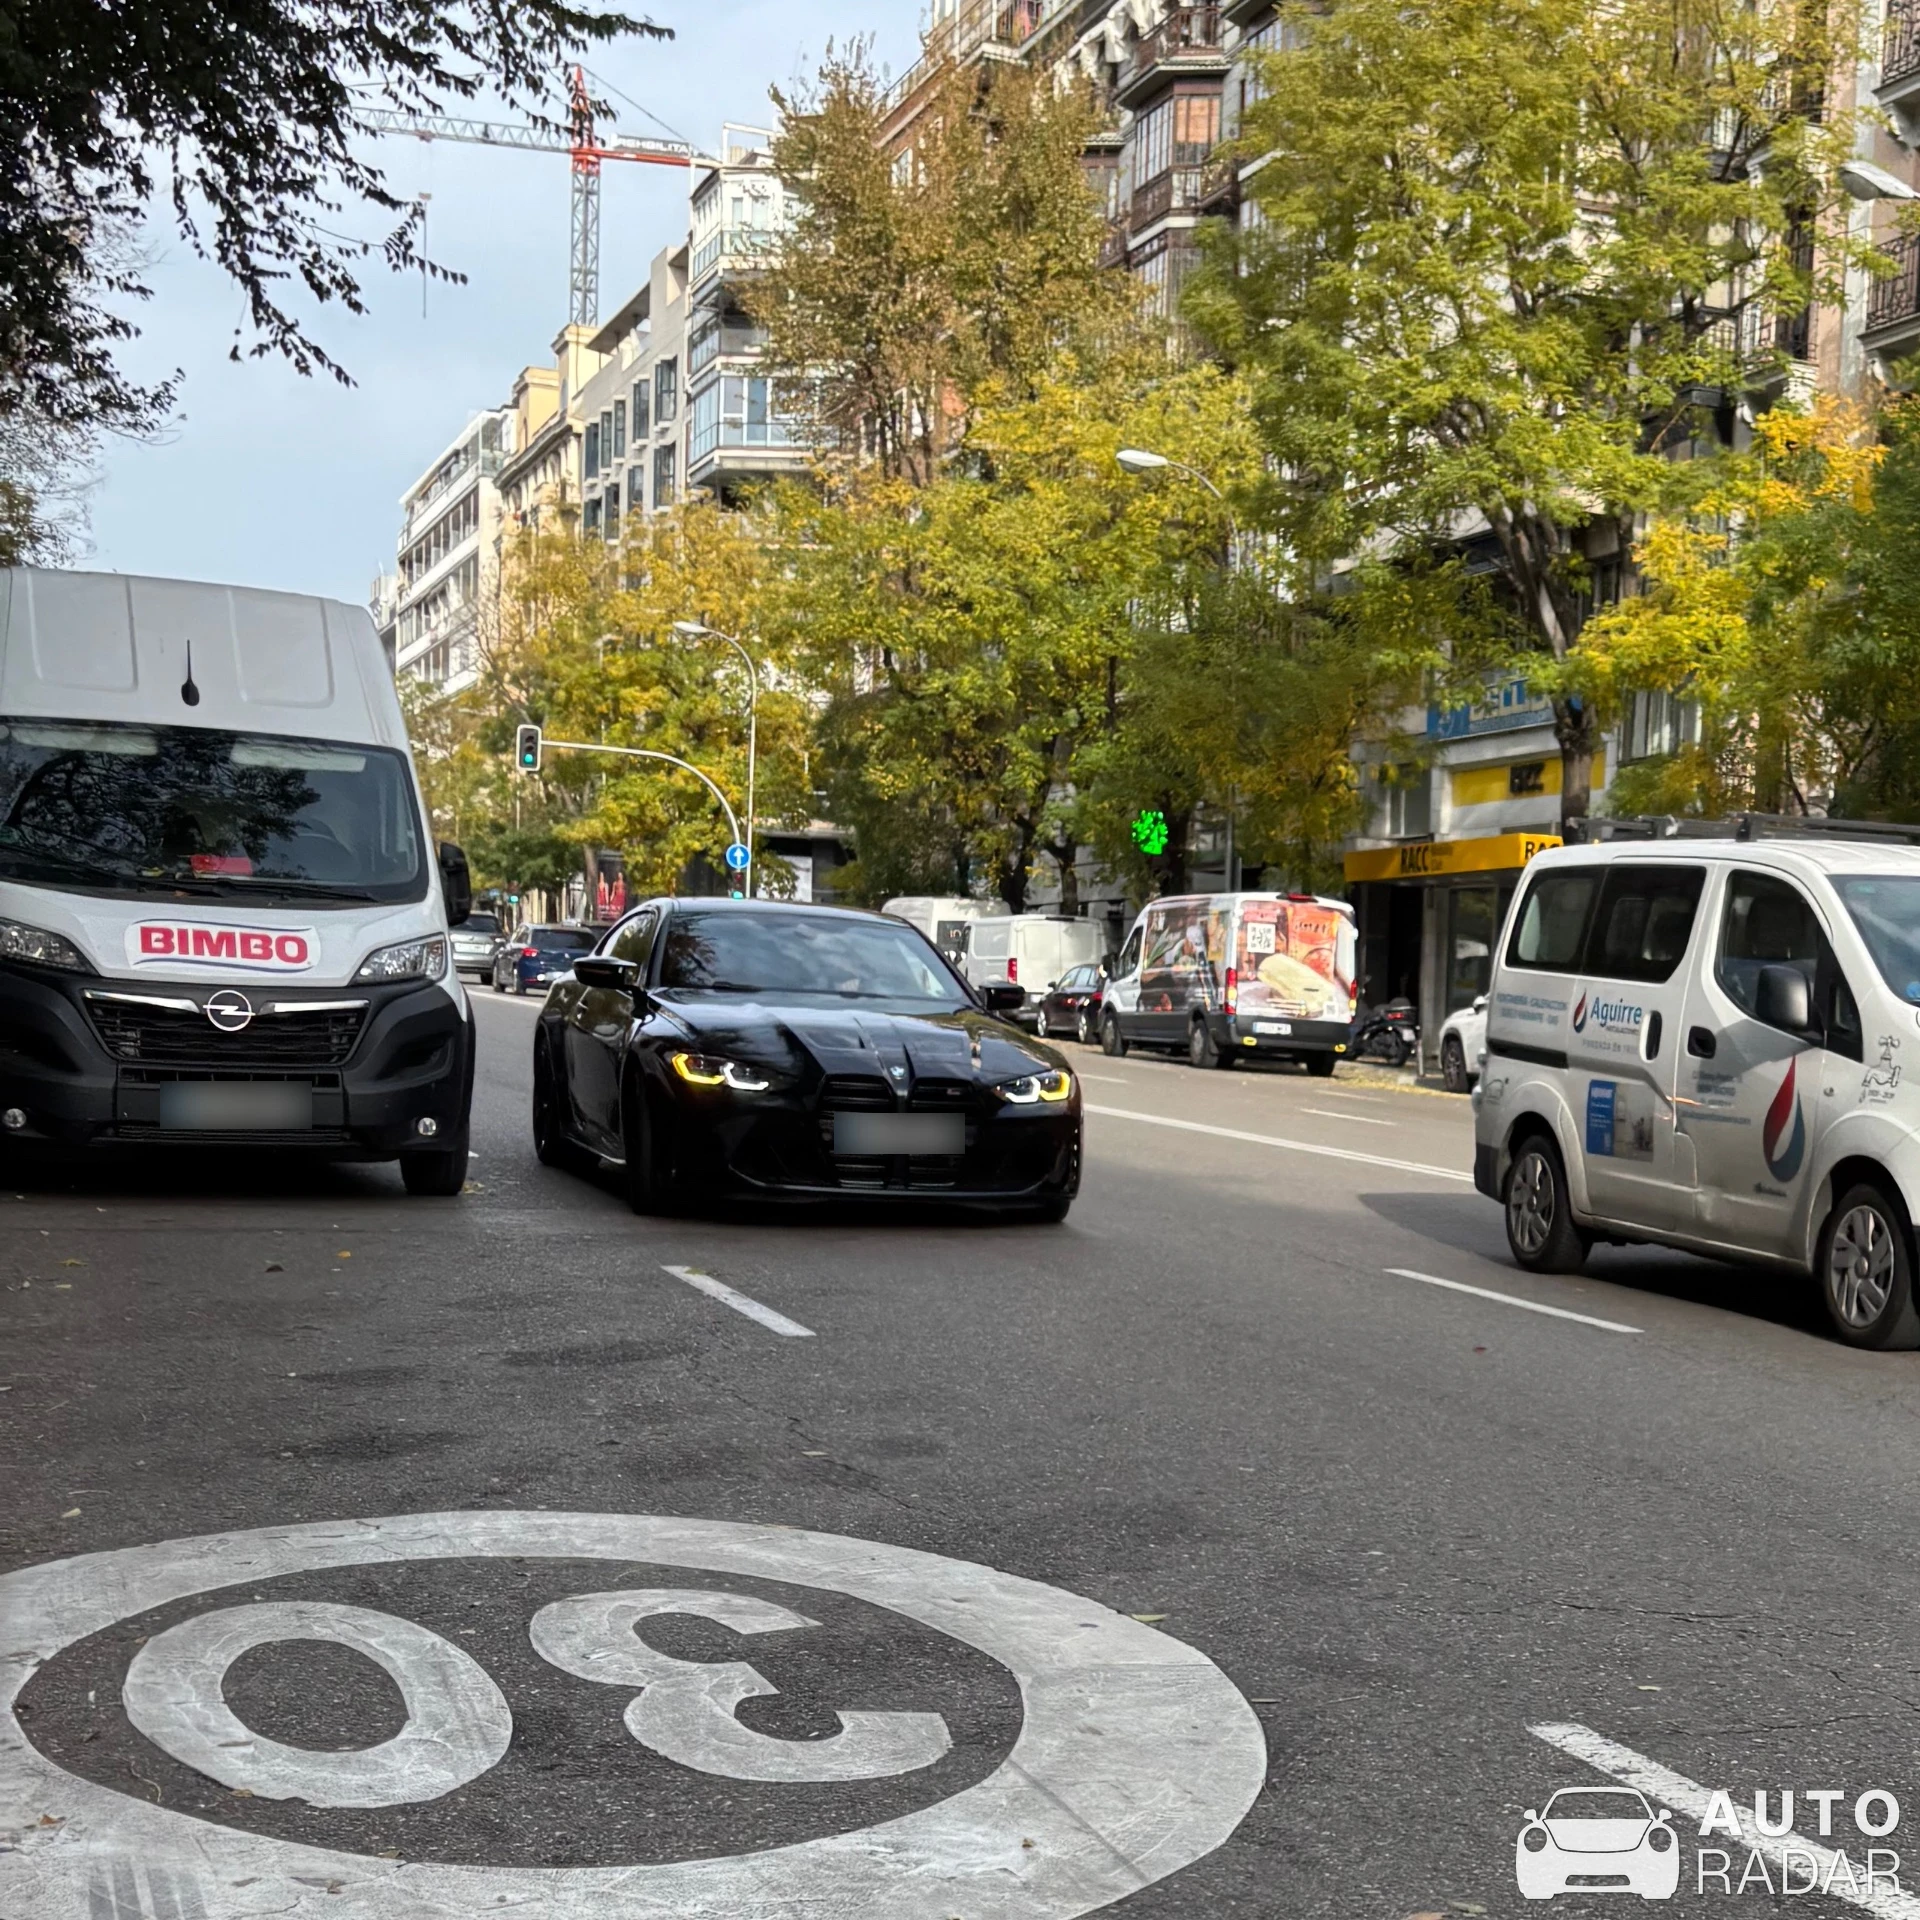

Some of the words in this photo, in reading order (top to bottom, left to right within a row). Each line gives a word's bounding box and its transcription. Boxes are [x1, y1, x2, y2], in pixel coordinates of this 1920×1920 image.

[1401, 846, 1428, 873] RACC
[140, 926, 308, 964] BIMBO
[1591, 996, 1642, 1028] Aguirre
[123, 1588, 955, 1808] 30
